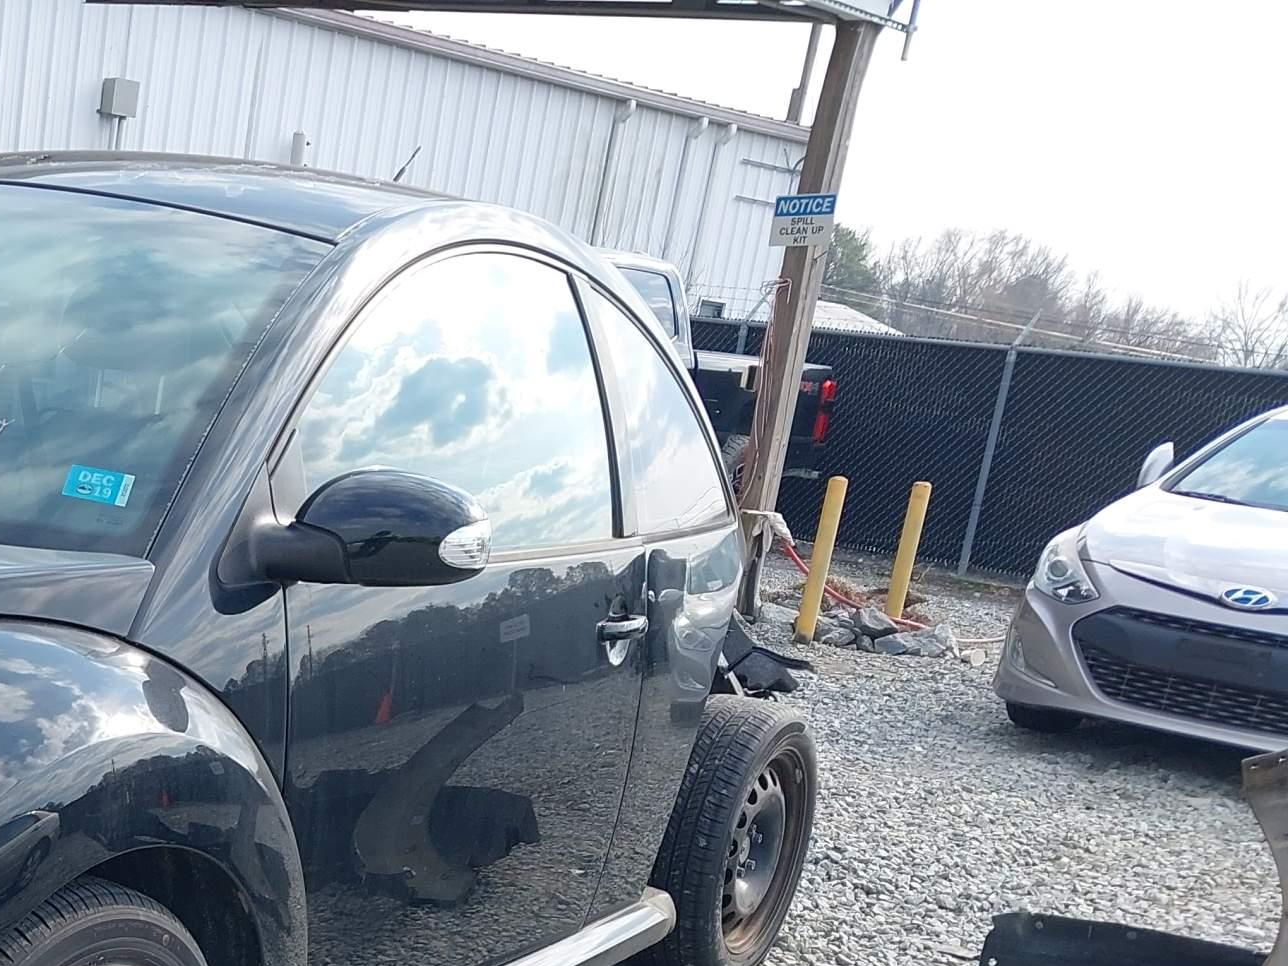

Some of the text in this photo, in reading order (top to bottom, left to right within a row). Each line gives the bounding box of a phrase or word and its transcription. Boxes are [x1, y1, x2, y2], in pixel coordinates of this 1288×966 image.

[777, 196, 834, 214] NOTICE
[791, 217, 815, 226] SPILL
[779, 225, 825, 236] CLEAN UP
[792, 235, 808, 245] KIT
[78, 470, 116, 487] DEC
[93, 486, 112, 498] 19
